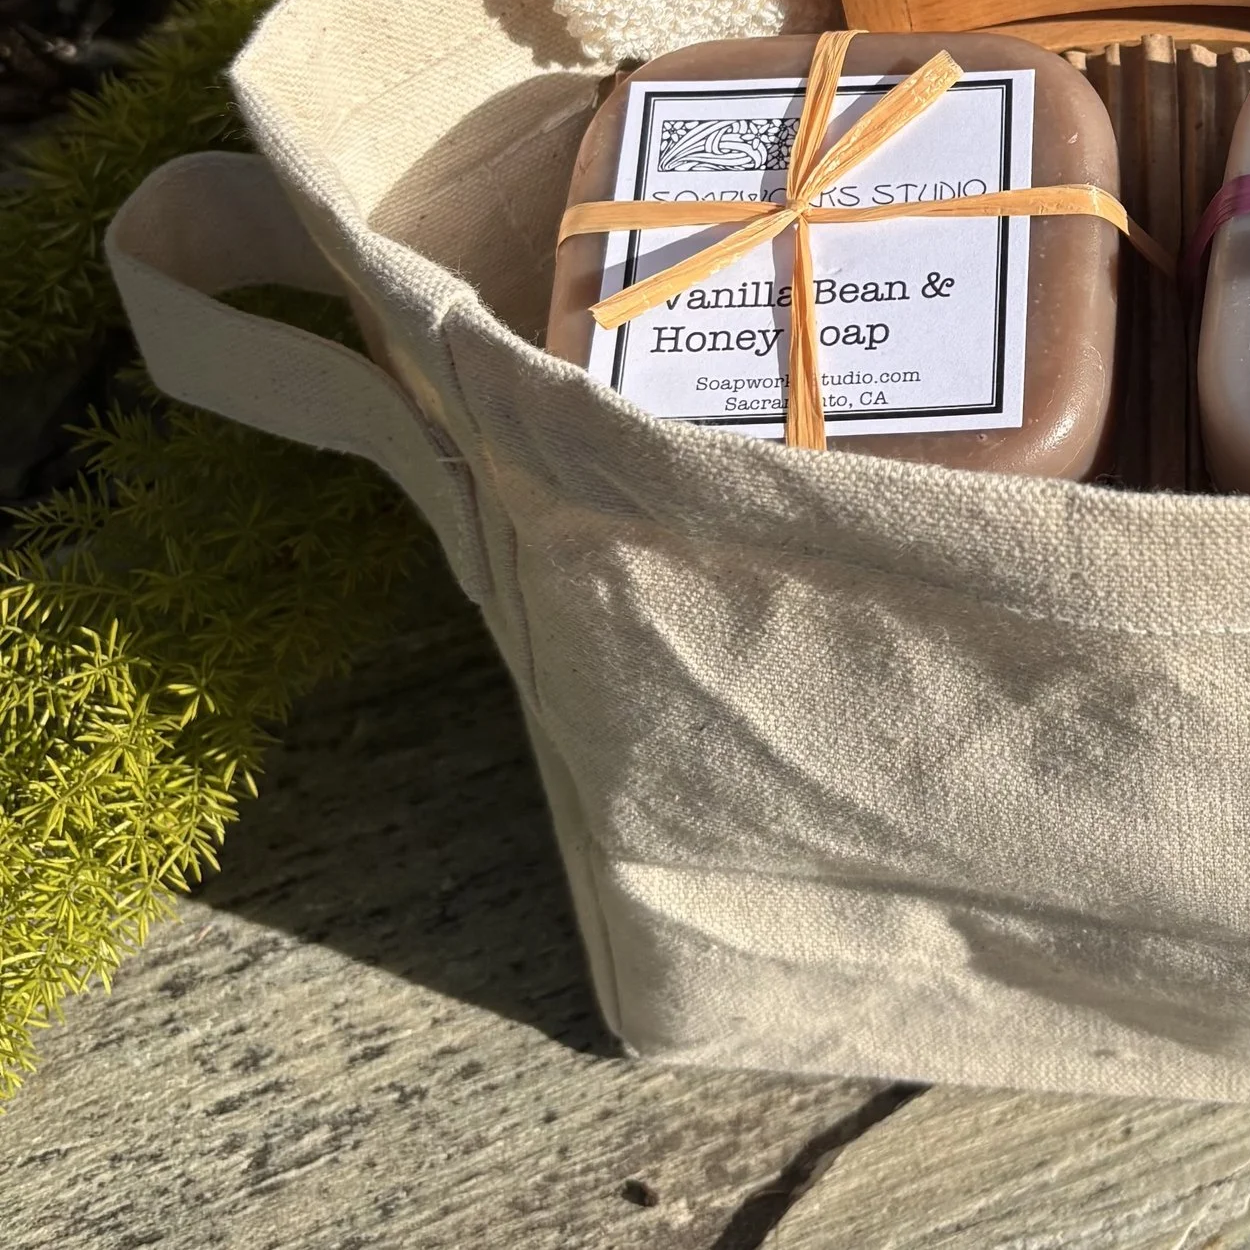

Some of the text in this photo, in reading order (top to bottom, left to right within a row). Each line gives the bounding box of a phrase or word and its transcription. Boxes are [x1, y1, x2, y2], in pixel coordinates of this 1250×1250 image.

[872, 179, 987, 204] STUDIO
[813, 278, 910, 305] Bean
[921, 271, 954, 298] &
[650, 321, 890, 357] Honey oap
[859, 391, 888, 405] CA
